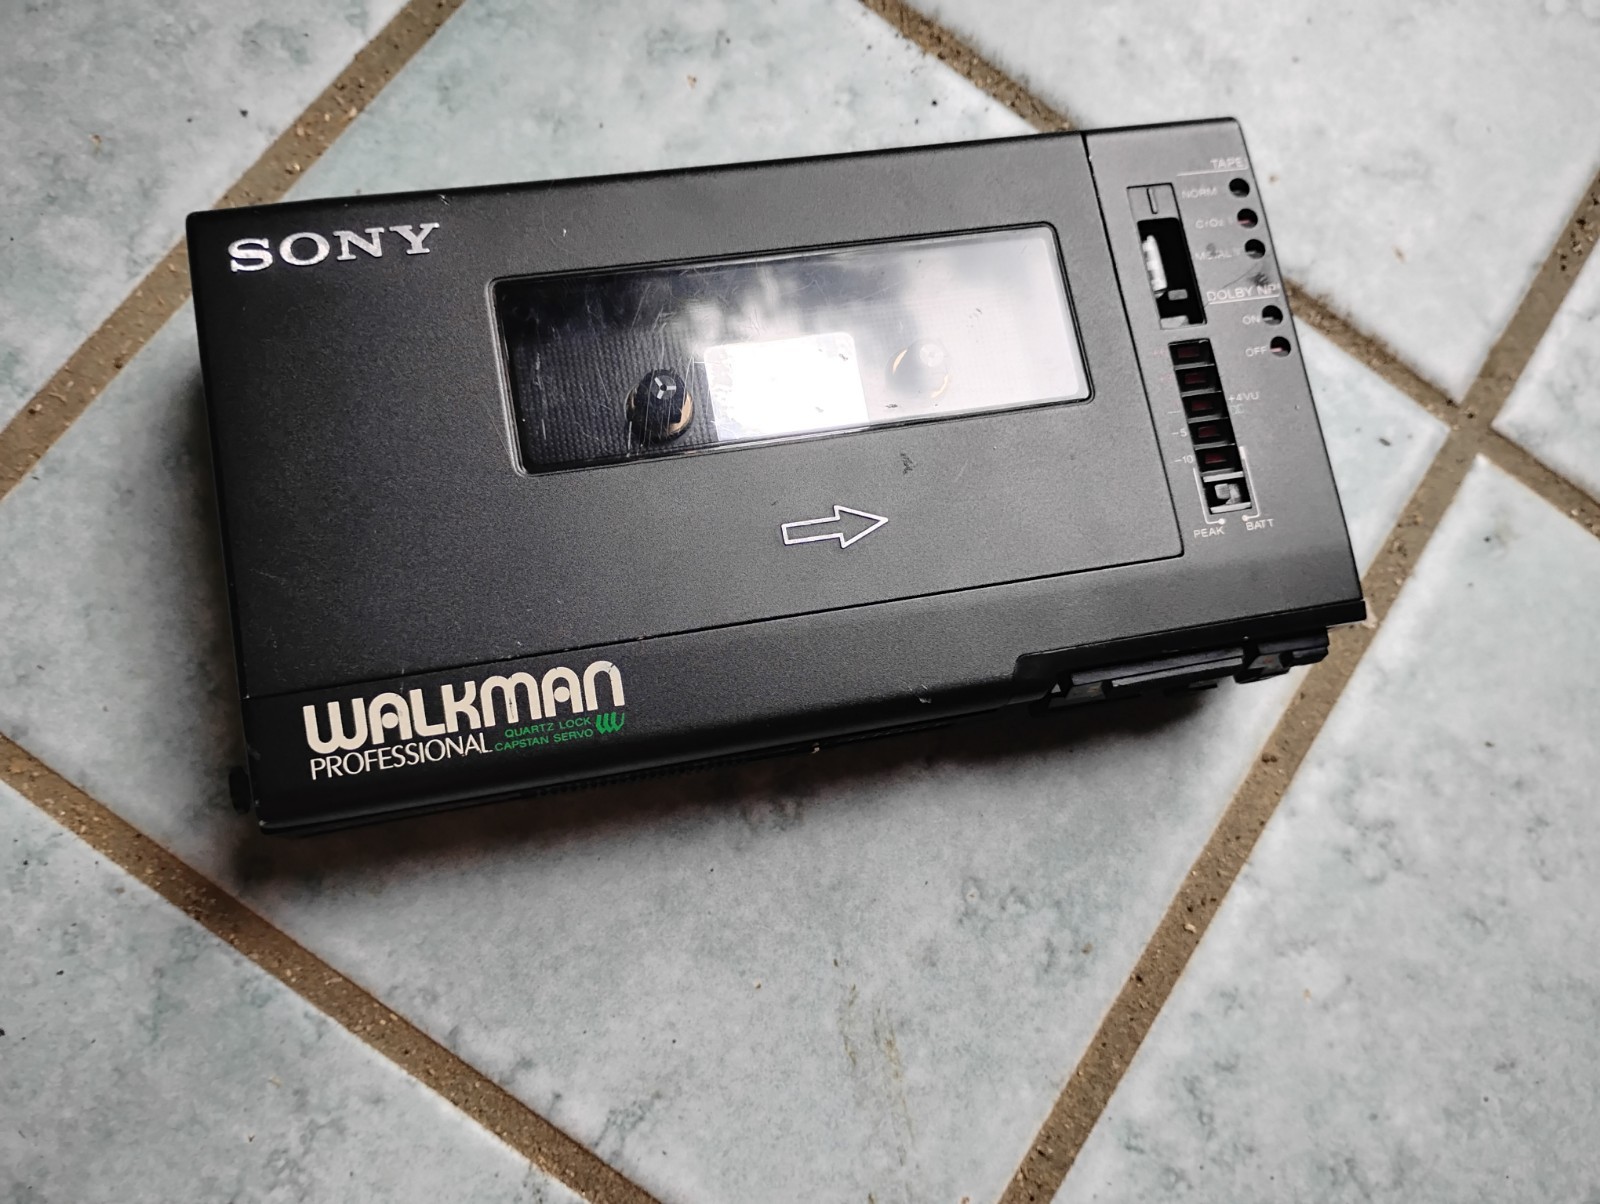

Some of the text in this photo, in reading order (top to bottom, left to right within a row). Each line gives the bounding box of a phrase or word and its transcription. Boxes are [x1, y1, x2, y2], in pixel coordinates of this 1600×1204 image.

[1209, 156, 1245, 169] TAPE
[1181, 186, 1218, 199] NORM
[228, 222, 440, 272] SONY
[1206, 286, 1253, 301] DOLBY
[1242, 314, 1260, 326] ON
[1245, 346, 1268, 358] OFF
[1193, 525, 1225, 539] PEAK
[1245, 518, 1275, 532] BATT
[303, 660, 626, 755] WALKMAN
[504, 717, 592, 739] QUARTZ LOCK
[494, 728, 594, 752] CAPSTAN SERVO
[309, 732, 494, 780] PROFESSIONAL
